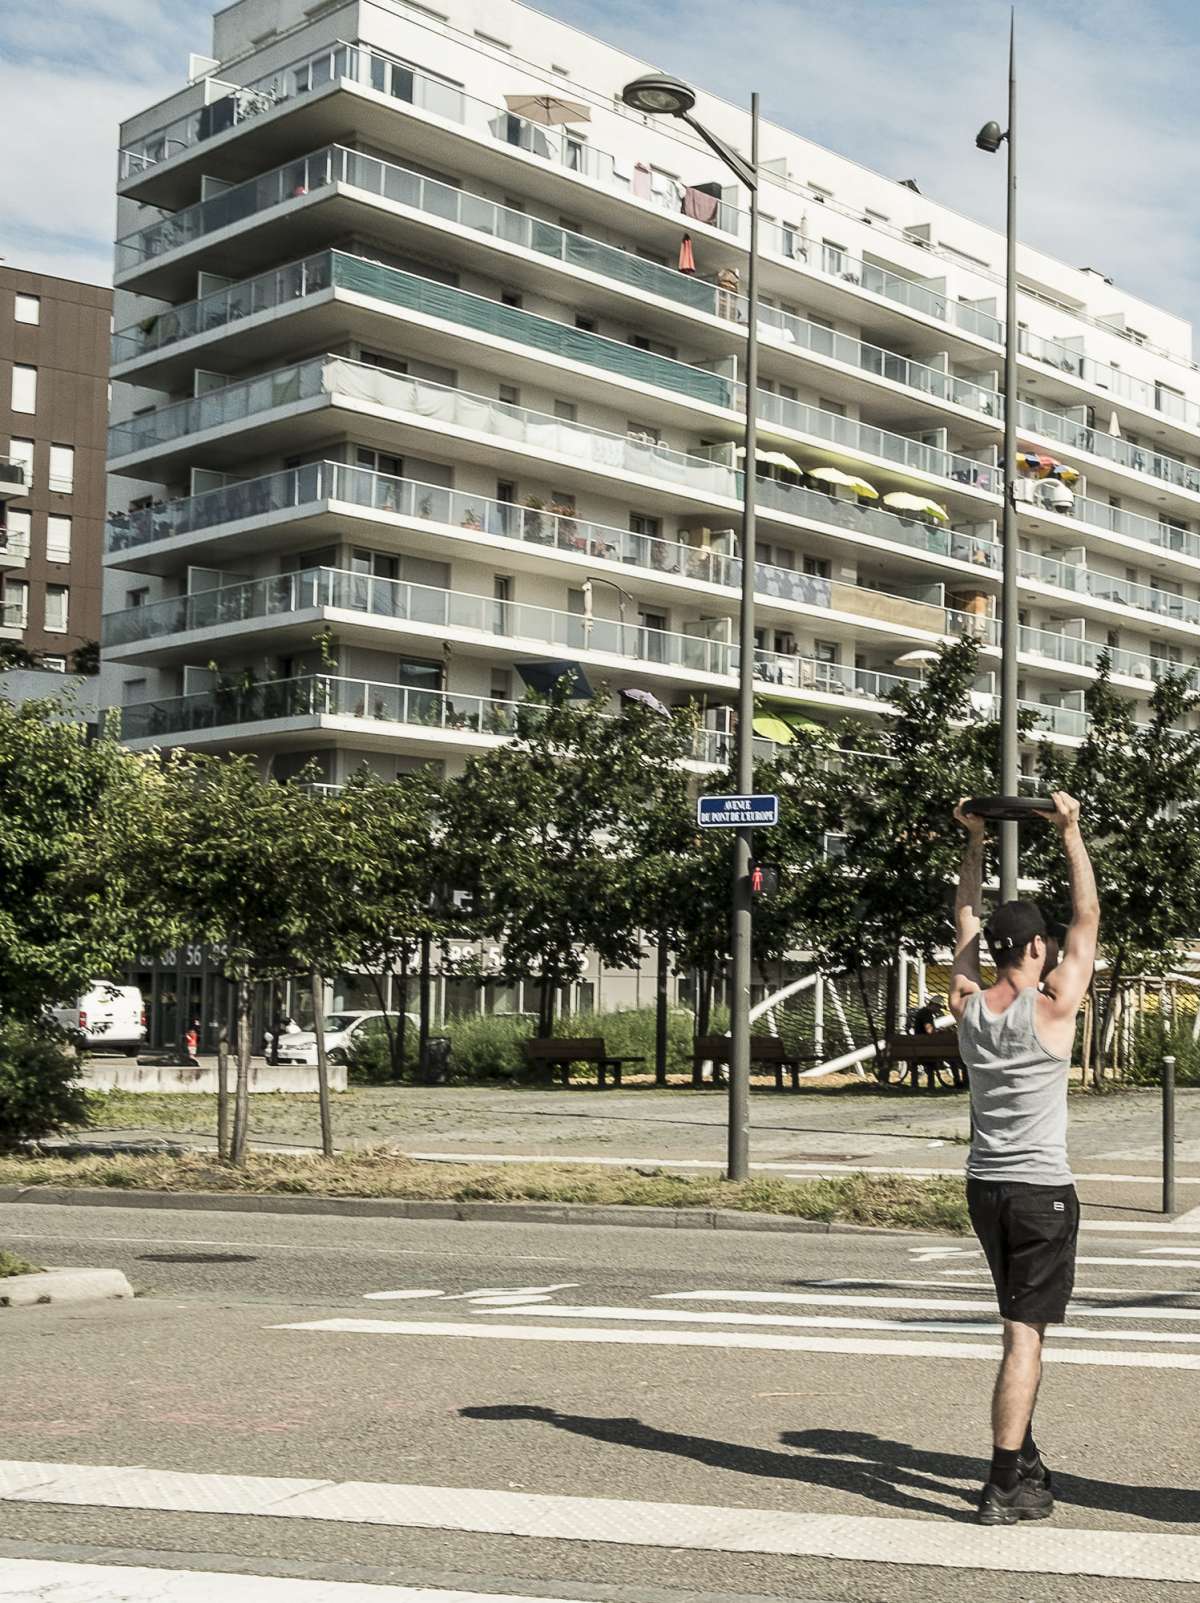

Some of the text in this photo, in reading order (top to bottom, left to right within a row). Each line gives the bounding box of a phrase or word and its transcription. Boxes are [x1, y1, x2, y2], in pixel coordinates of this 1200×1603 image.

[724, 800, 752, 810] AVENUE
[701, 810, 773, 823] DU PONT DE L'EUROPE
[186, 944, 202, 966] 56
